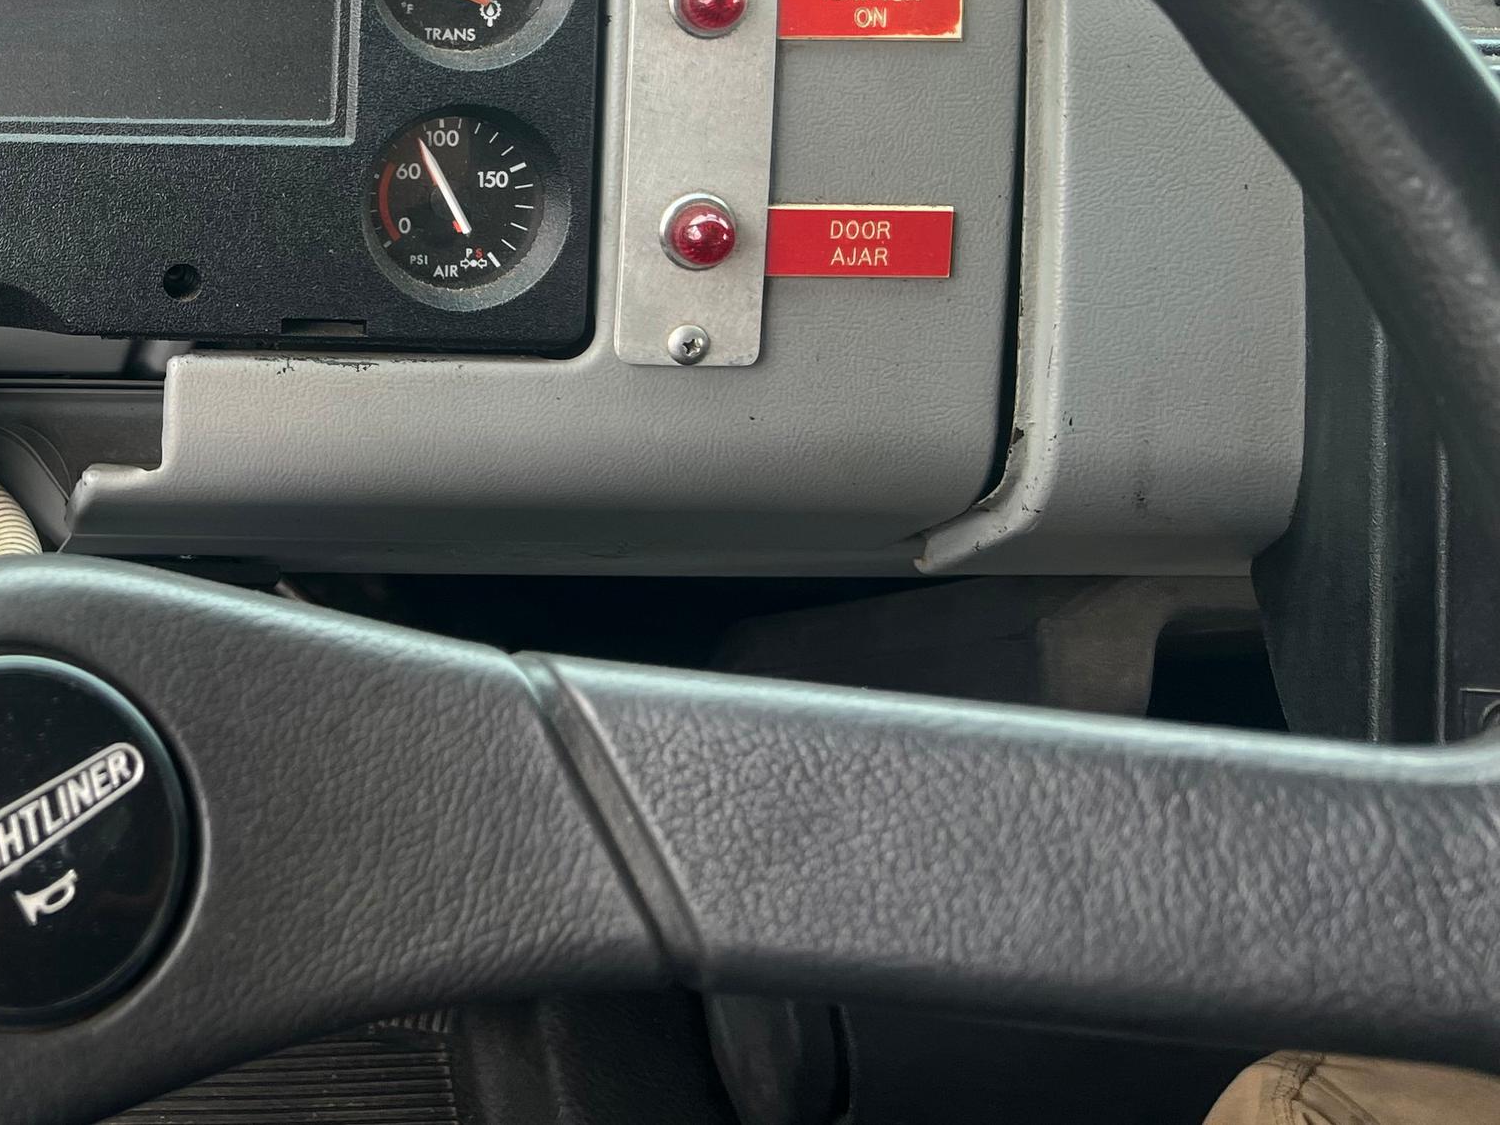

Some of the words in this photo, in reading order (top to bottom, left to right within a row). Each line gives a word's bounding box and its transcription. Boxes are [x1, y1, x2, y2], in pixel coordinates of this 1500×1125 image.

[854, 7, 887, 28] ON
[424, 27, 476, 42] TRANS
[426, 130, 460, 147] 100
[396, 163, 422, 179] 60
[477, 171, 509, 188] 150
[399, 217, 411, 234] 0
[830, 220, 891, 240] DOOR
[410, 254, 428, 265] PSI
[830, 247, 889, 266] AJAR
[433, 264, 459, 278] AIR
